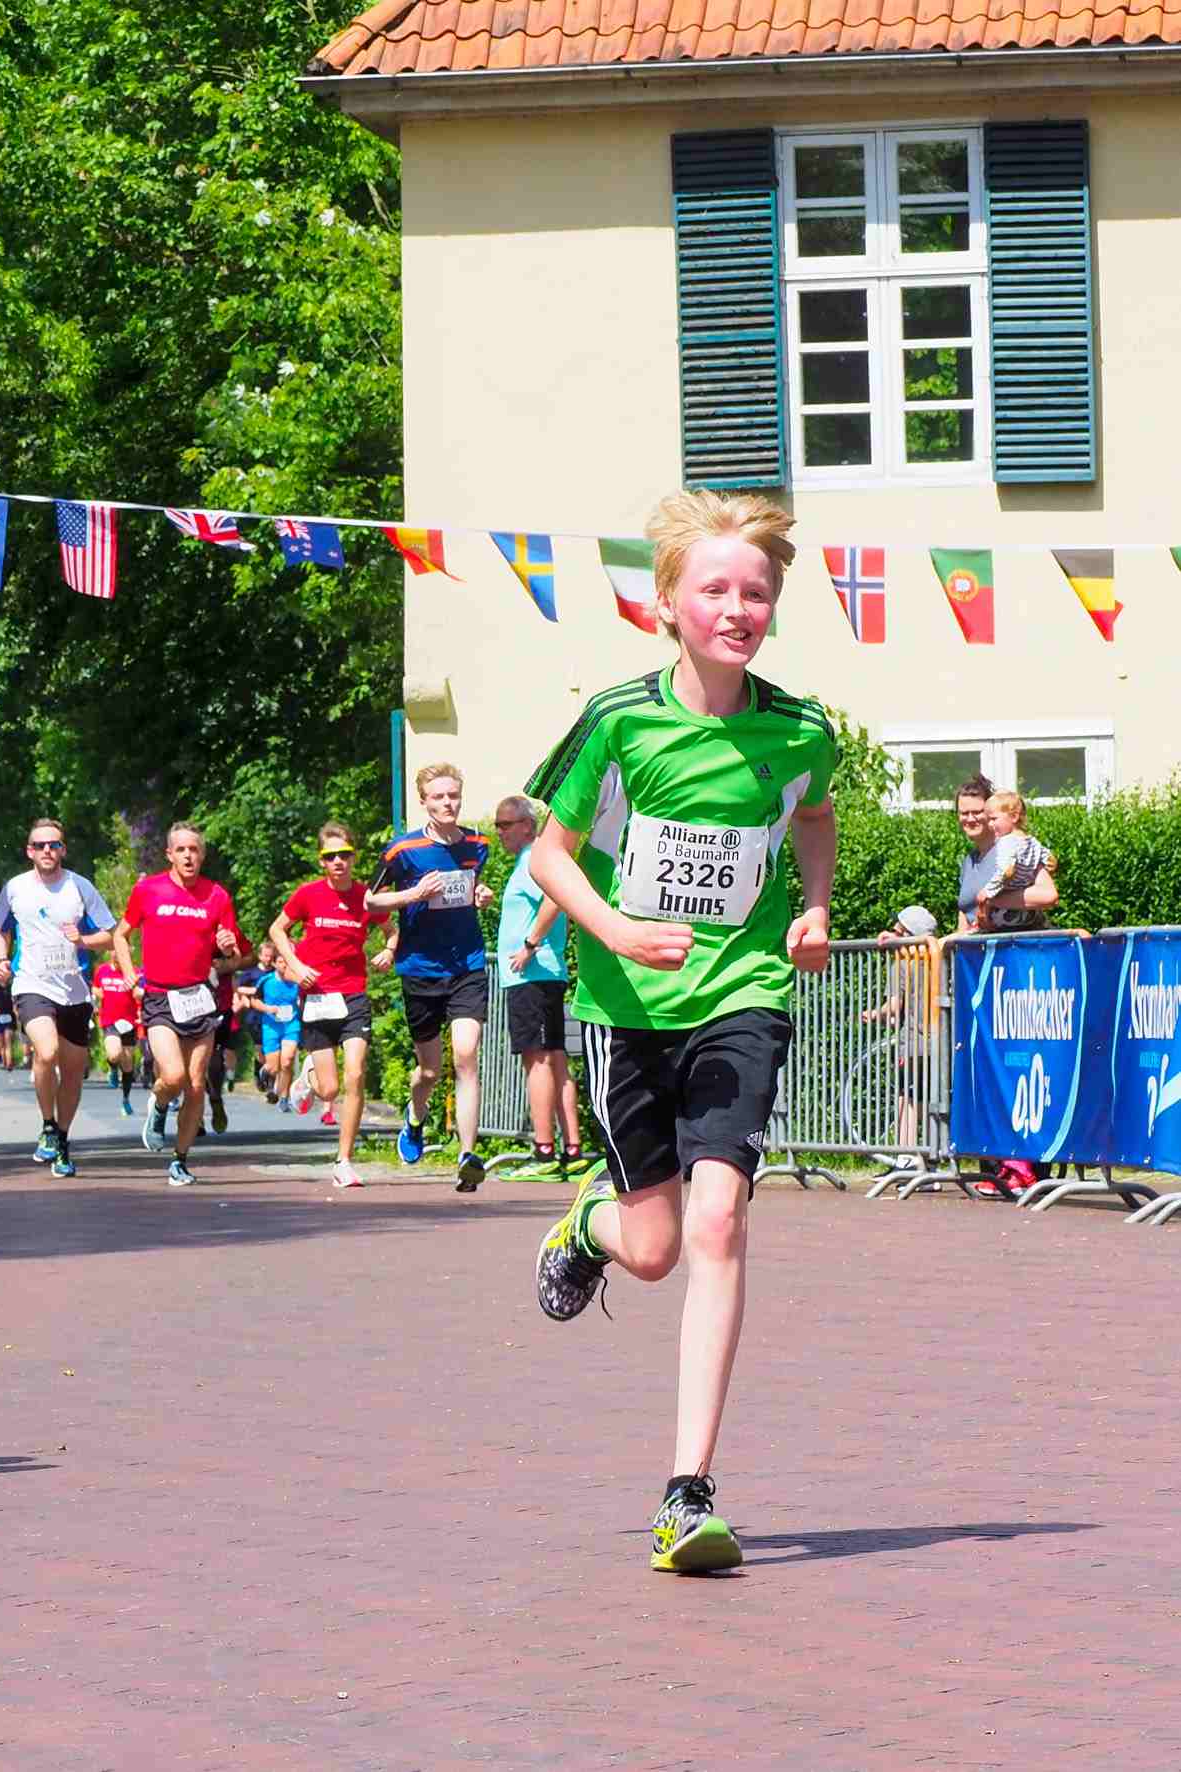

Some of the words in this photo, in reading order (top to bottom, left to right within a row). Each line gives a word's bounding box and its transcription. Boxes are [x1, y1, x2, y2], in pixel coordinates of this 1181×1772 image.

[659, 824, 717, 846] Allianz
[674, 843, 739, 862] Baumann
[655, 858, 735, 889] 2326
[658, 886, 726, 916] bruns
[992, 964, 1075, 1040] Krombacher
